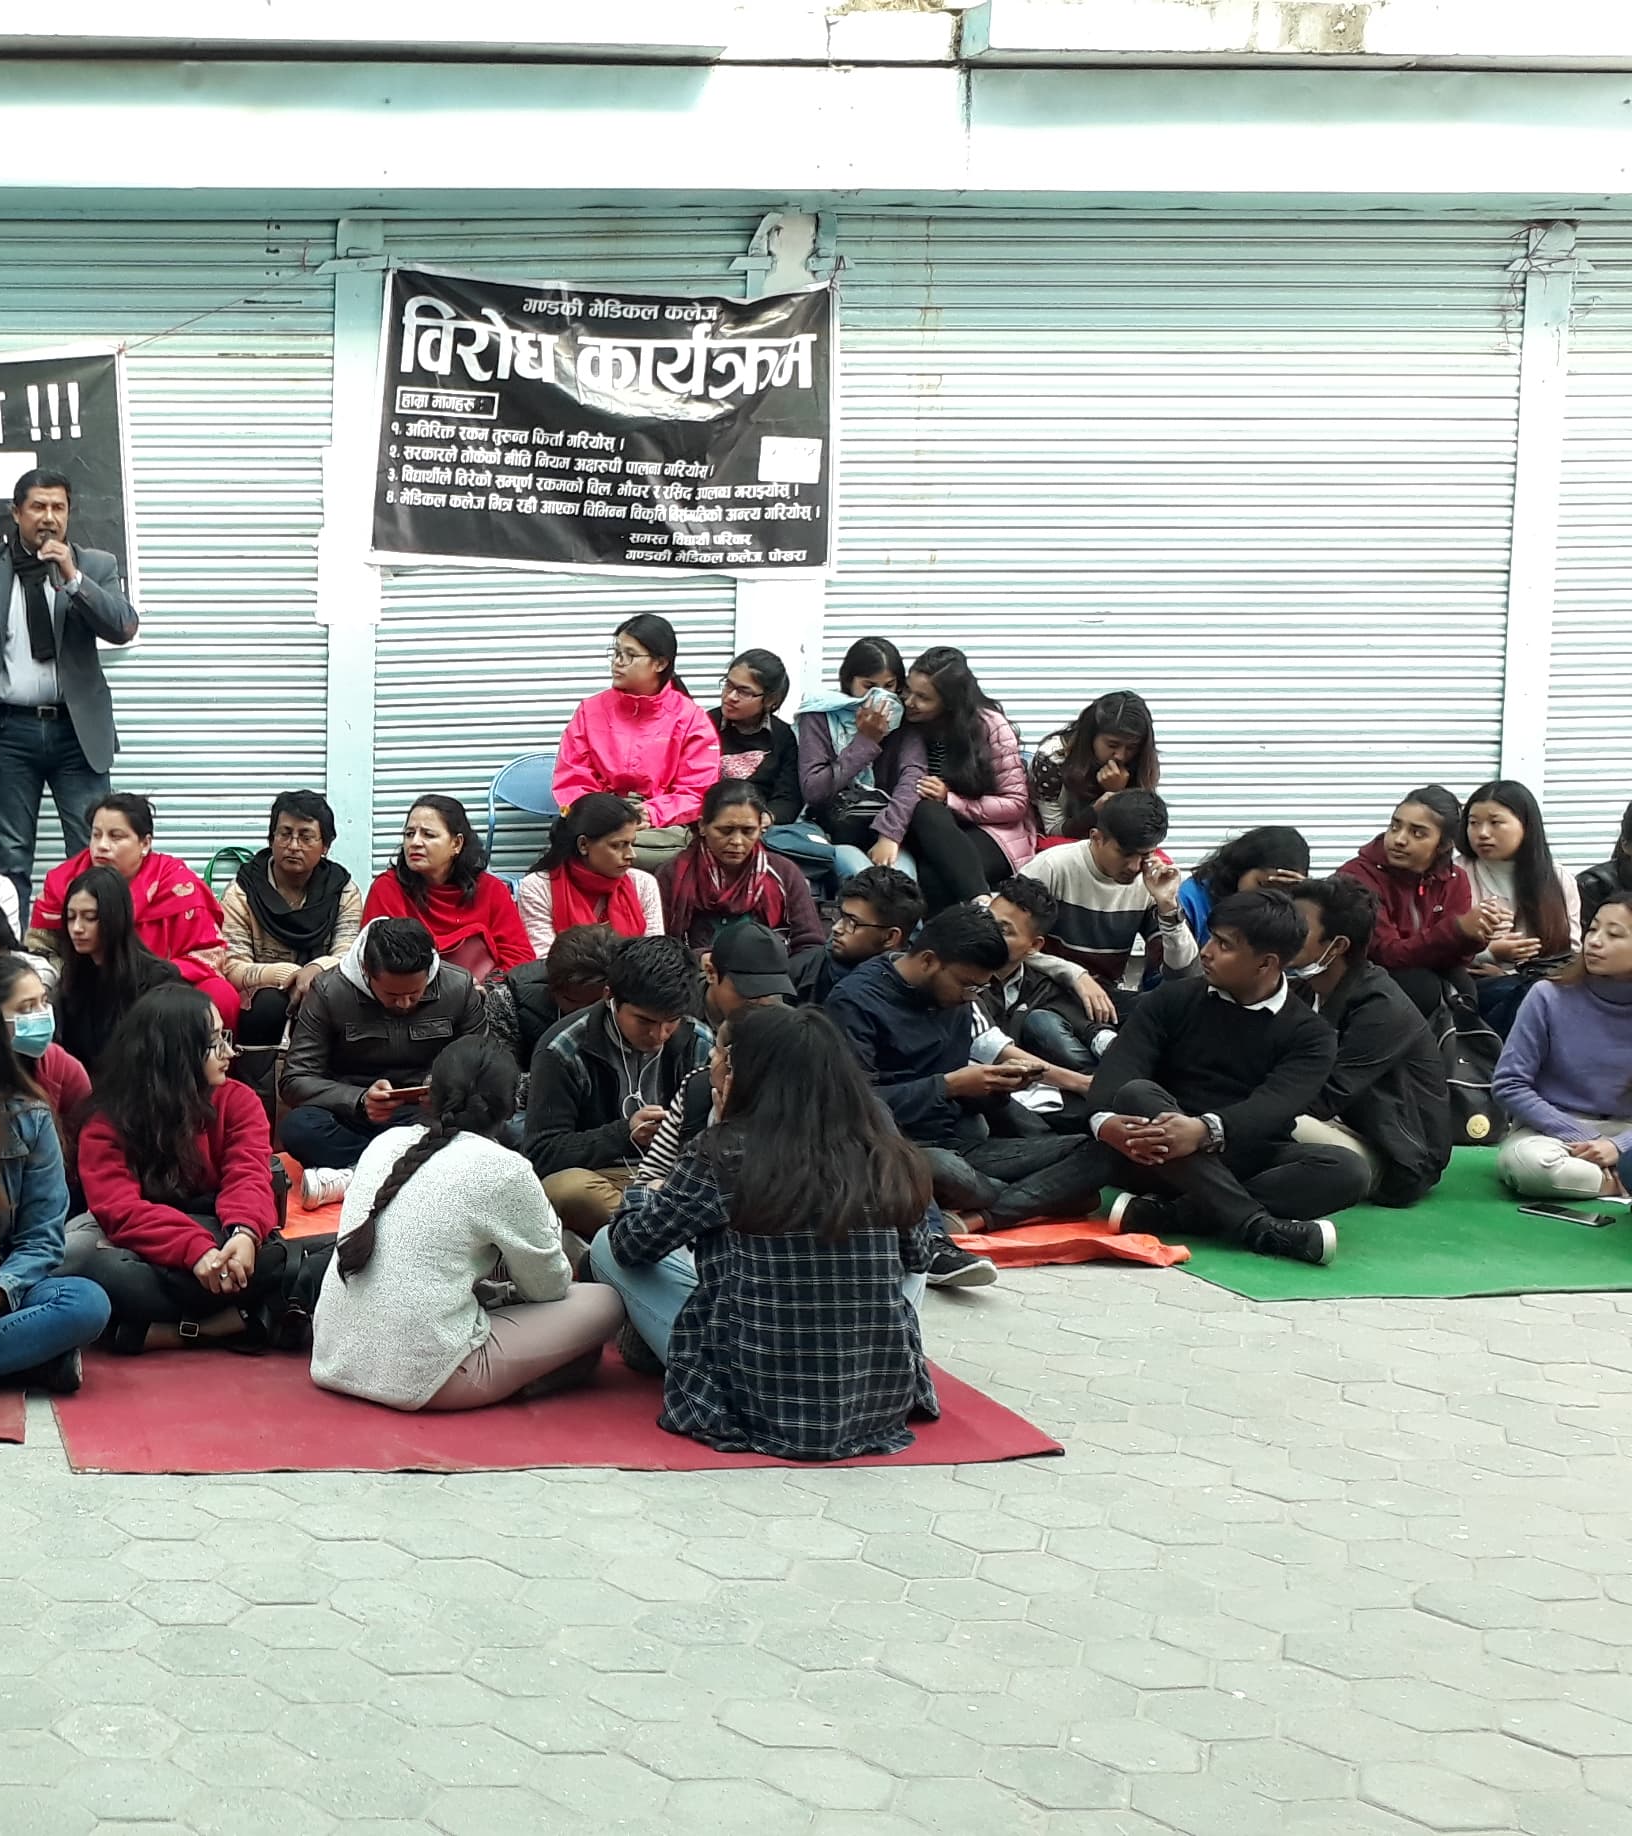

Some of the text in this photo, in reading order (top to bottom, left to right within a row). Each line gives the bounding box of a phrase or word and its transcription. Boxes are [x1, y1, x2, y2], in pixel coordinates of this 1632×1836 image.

[522, 297, 719, 321] गण्डकी मेडिकल कलेज
[400, 295, 818, 400] विरोध कार्यक्रम
[459, 426, 490, 442] रकम
[403, 445, 458, 463] सरकारले
[535, 450, 571, 470] नियम
[536, 477, 584, 495] रकमको
[399, 488, 447, 508] मेडिकल
[449, 492, 486, 510] कलेज
[516, 495, 538, 514] रही
[540, 500, 581, 516] आएका
[625, 549, 672, 562] गण्डकी
[675, 549, 724, 564] मेडिकल
[768, 548, 808, 562] पोखरा
